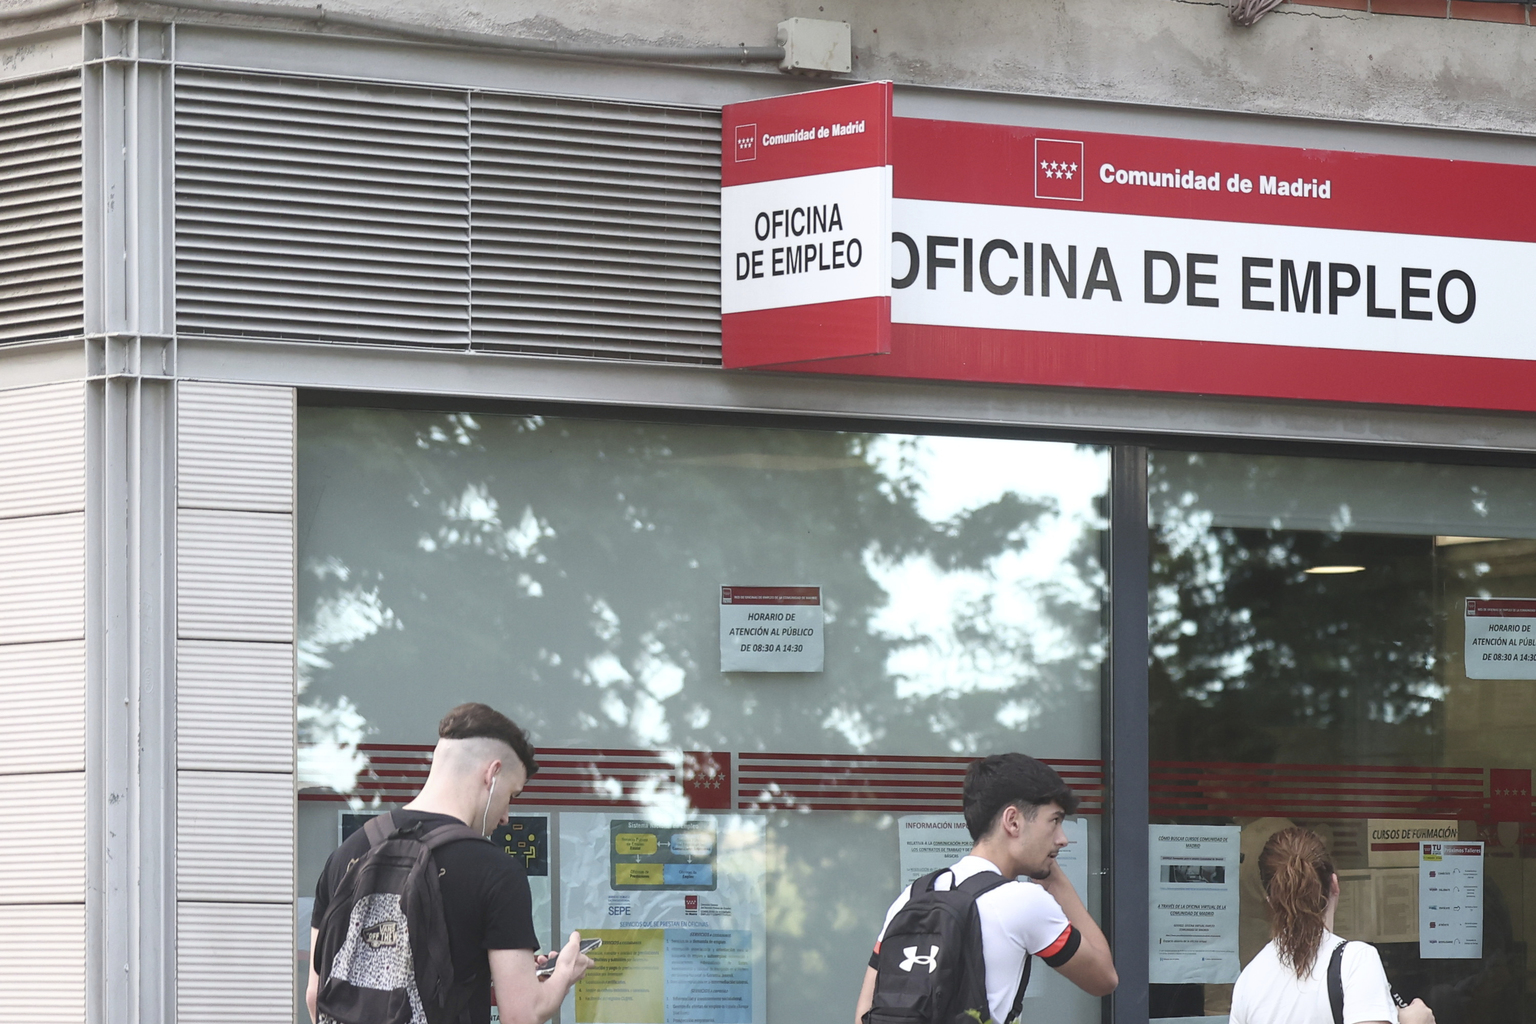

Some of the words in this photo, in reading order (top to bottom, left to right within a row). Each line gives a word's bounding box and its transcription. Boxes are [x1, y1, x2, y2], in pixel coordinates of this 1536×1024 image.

[762, 127, 816, 147] Comunidad
[817, 125, 830, 139] de
[831, 120, 865, 137] Madrid
[1099, 162, 1221, 192] Comunidad
[1227, 172, 1253, 194] de
[1259, 175, 1332, 199] Madrid
[754, 203, 843, 241] OFICINA
[736, 250, 764, 281] DE
[772, 238, 862, 278] EMPLEO
[891, 231, 1123, 302] OFICINA
[1144, 249, 1220, 308] DE
[1241, 255, 1477, 324] EMPLEO
[747, 613, 784, 621] HORARIO
[785, 613, 796, 621] DE
[729, 626, 769, 636] ATENCIÓN
[770, 628, 780, 636] AL
[781, 626, 814, 636] PÚBLICO
[1488, 624, 1521, 632] HORARIO
[1472, 637, 1507, 646] ATENCIÓN
[740, 644, 751, 652] DE
[752, 644, 774, 652] 08:30
[775, 644, 781, 652] A
[782, 644, 803, 652] 14:30
[1482, 653, 1492, 661] DE
[1493, 653, 1512, 661] 08:30
[1513, 653, 1518, 661] A
[905, 821, 952, 829] INFORMACIÓN
[1372, 829, 1400, 840] CURSOS
[1401, 829, 1411, 839] DE
[608, 906, 631, 916] SEPE
